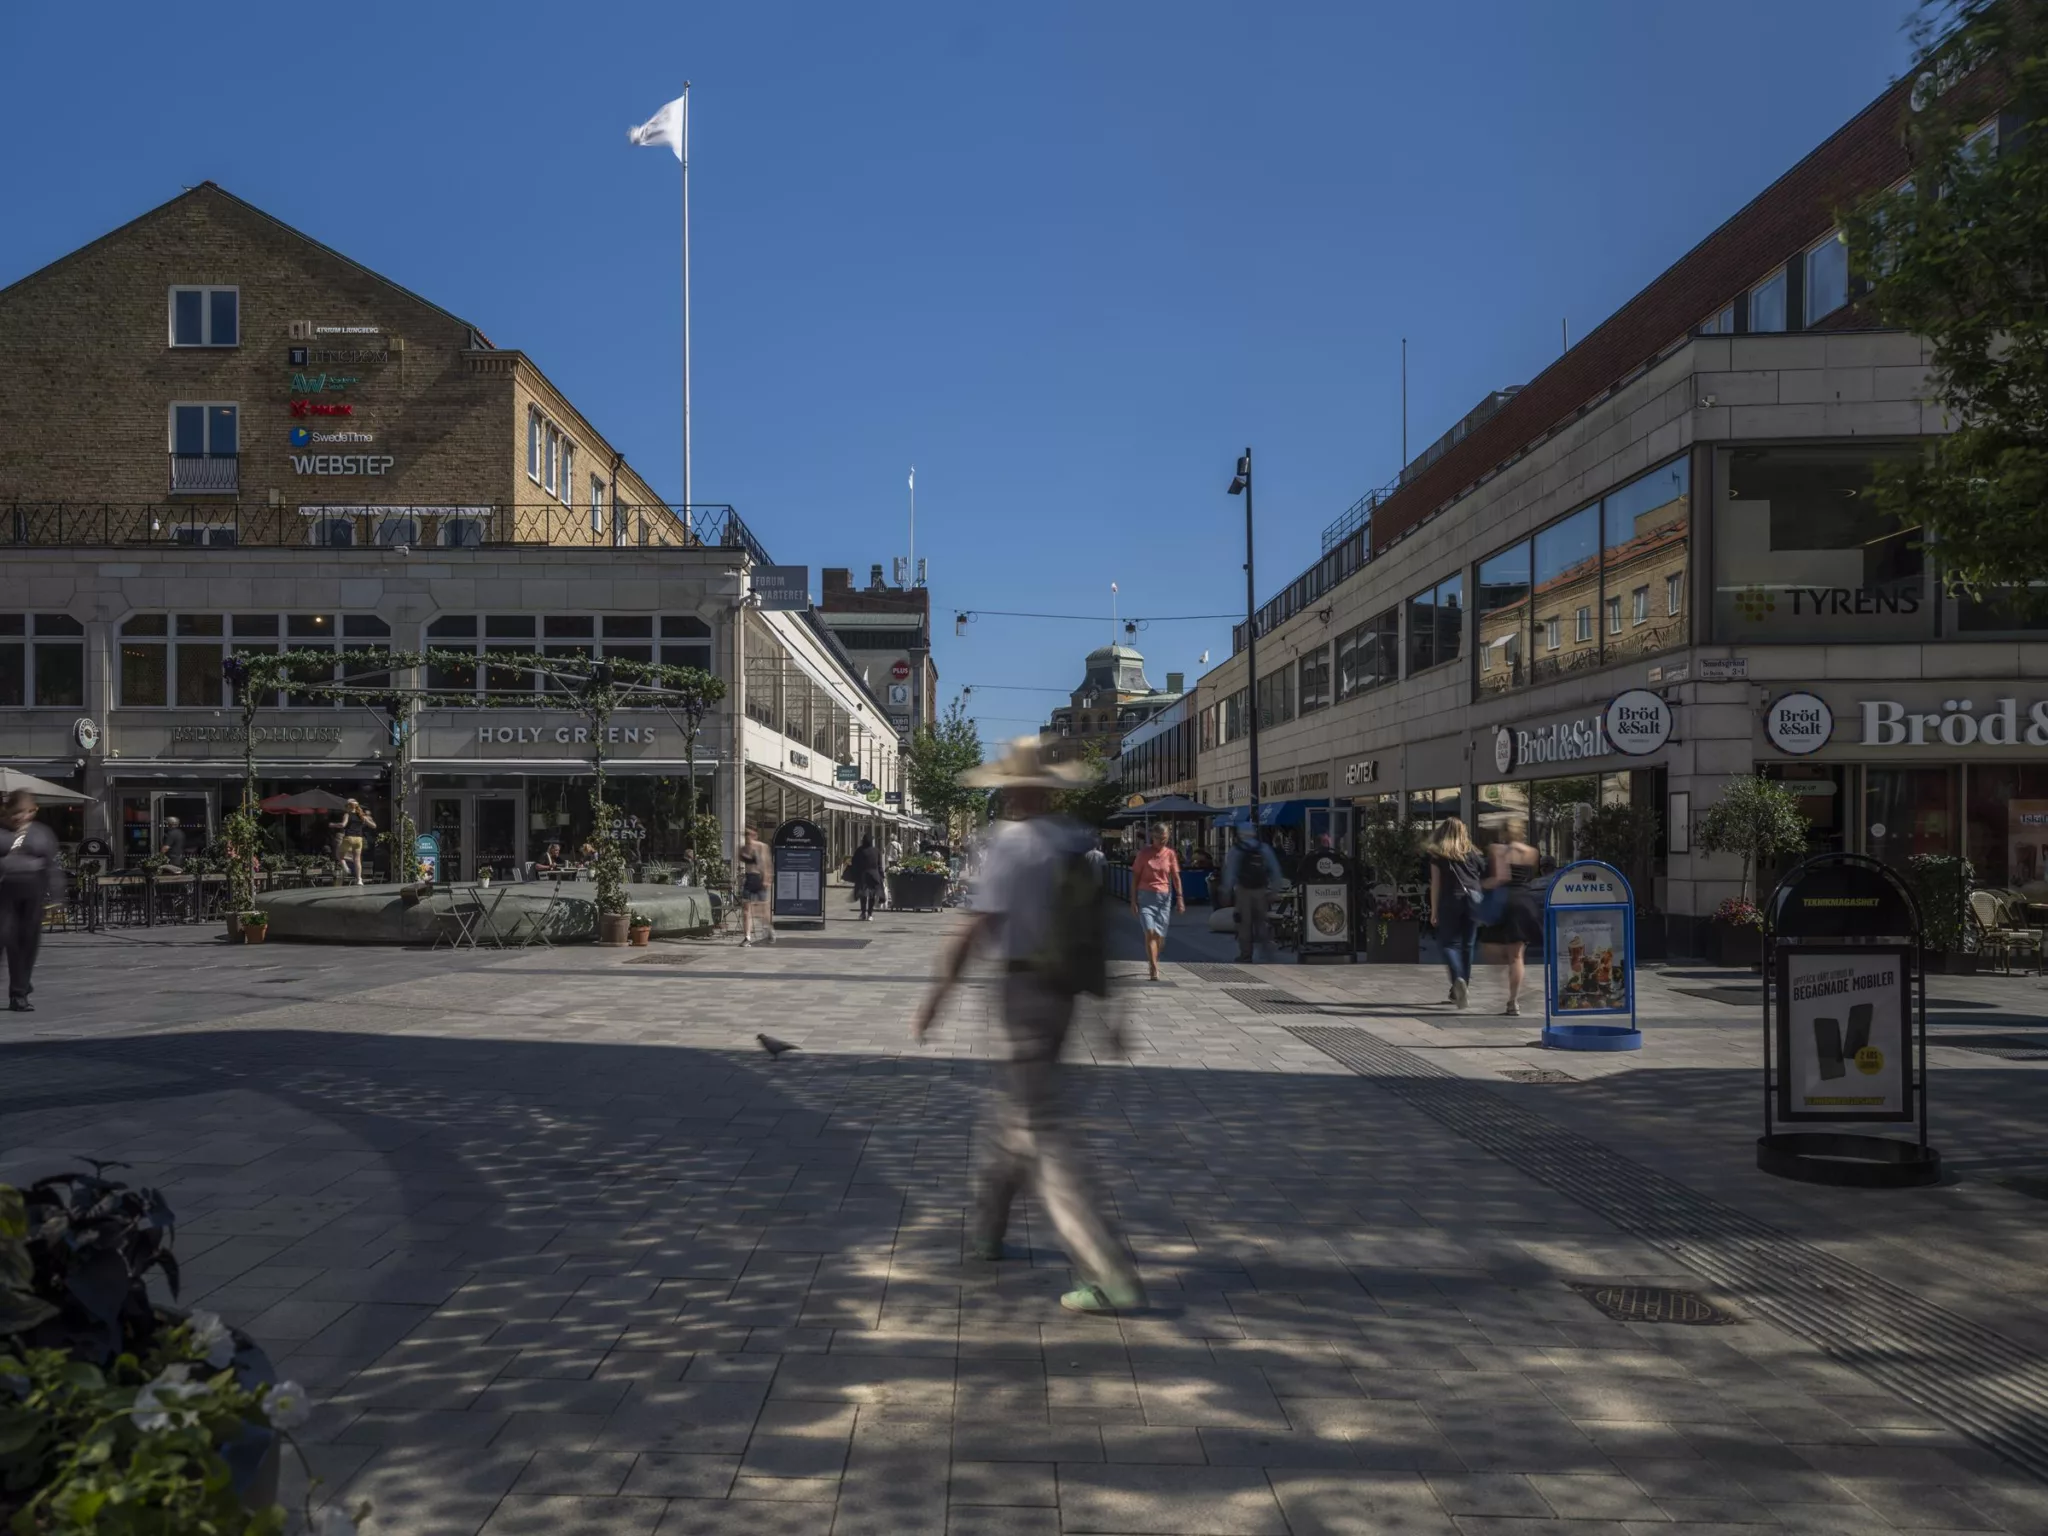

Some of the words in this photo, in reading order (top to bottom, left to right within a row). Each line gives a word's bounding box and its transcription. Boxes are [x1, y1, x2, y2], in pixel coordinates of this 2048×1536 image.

[289, 455, 394, 475] WEBSTEP
[755, 576, 785, 587] FORUM
[1618, 707, 1659, 720] Bröd
[1780, 709, 1820, 722] Bröd
[1617, 721, 1660, 734] &Salt
[1779, 722, 1822, 735] &Salt
[274, 727, 342, 743] HOUSE
[478, 727, 542, 743] HOLY
[555, 727, 656, 744] GRENS
[1345, 760, 1374, 786] HEMTEX
[604, 819, 637, 828] OLY
[600, 829, 647, 840] EENS
[1315, 889, 1341, 897] Sallad
[1565, 883, 1613, 892] WAYNES
[1802, 898, 1880, 907] TEKNIKMAGASINET
[1793, 979, 1850, 1001] BEGAGNADE
[1852, 971, 1895, 991] MOBILER
